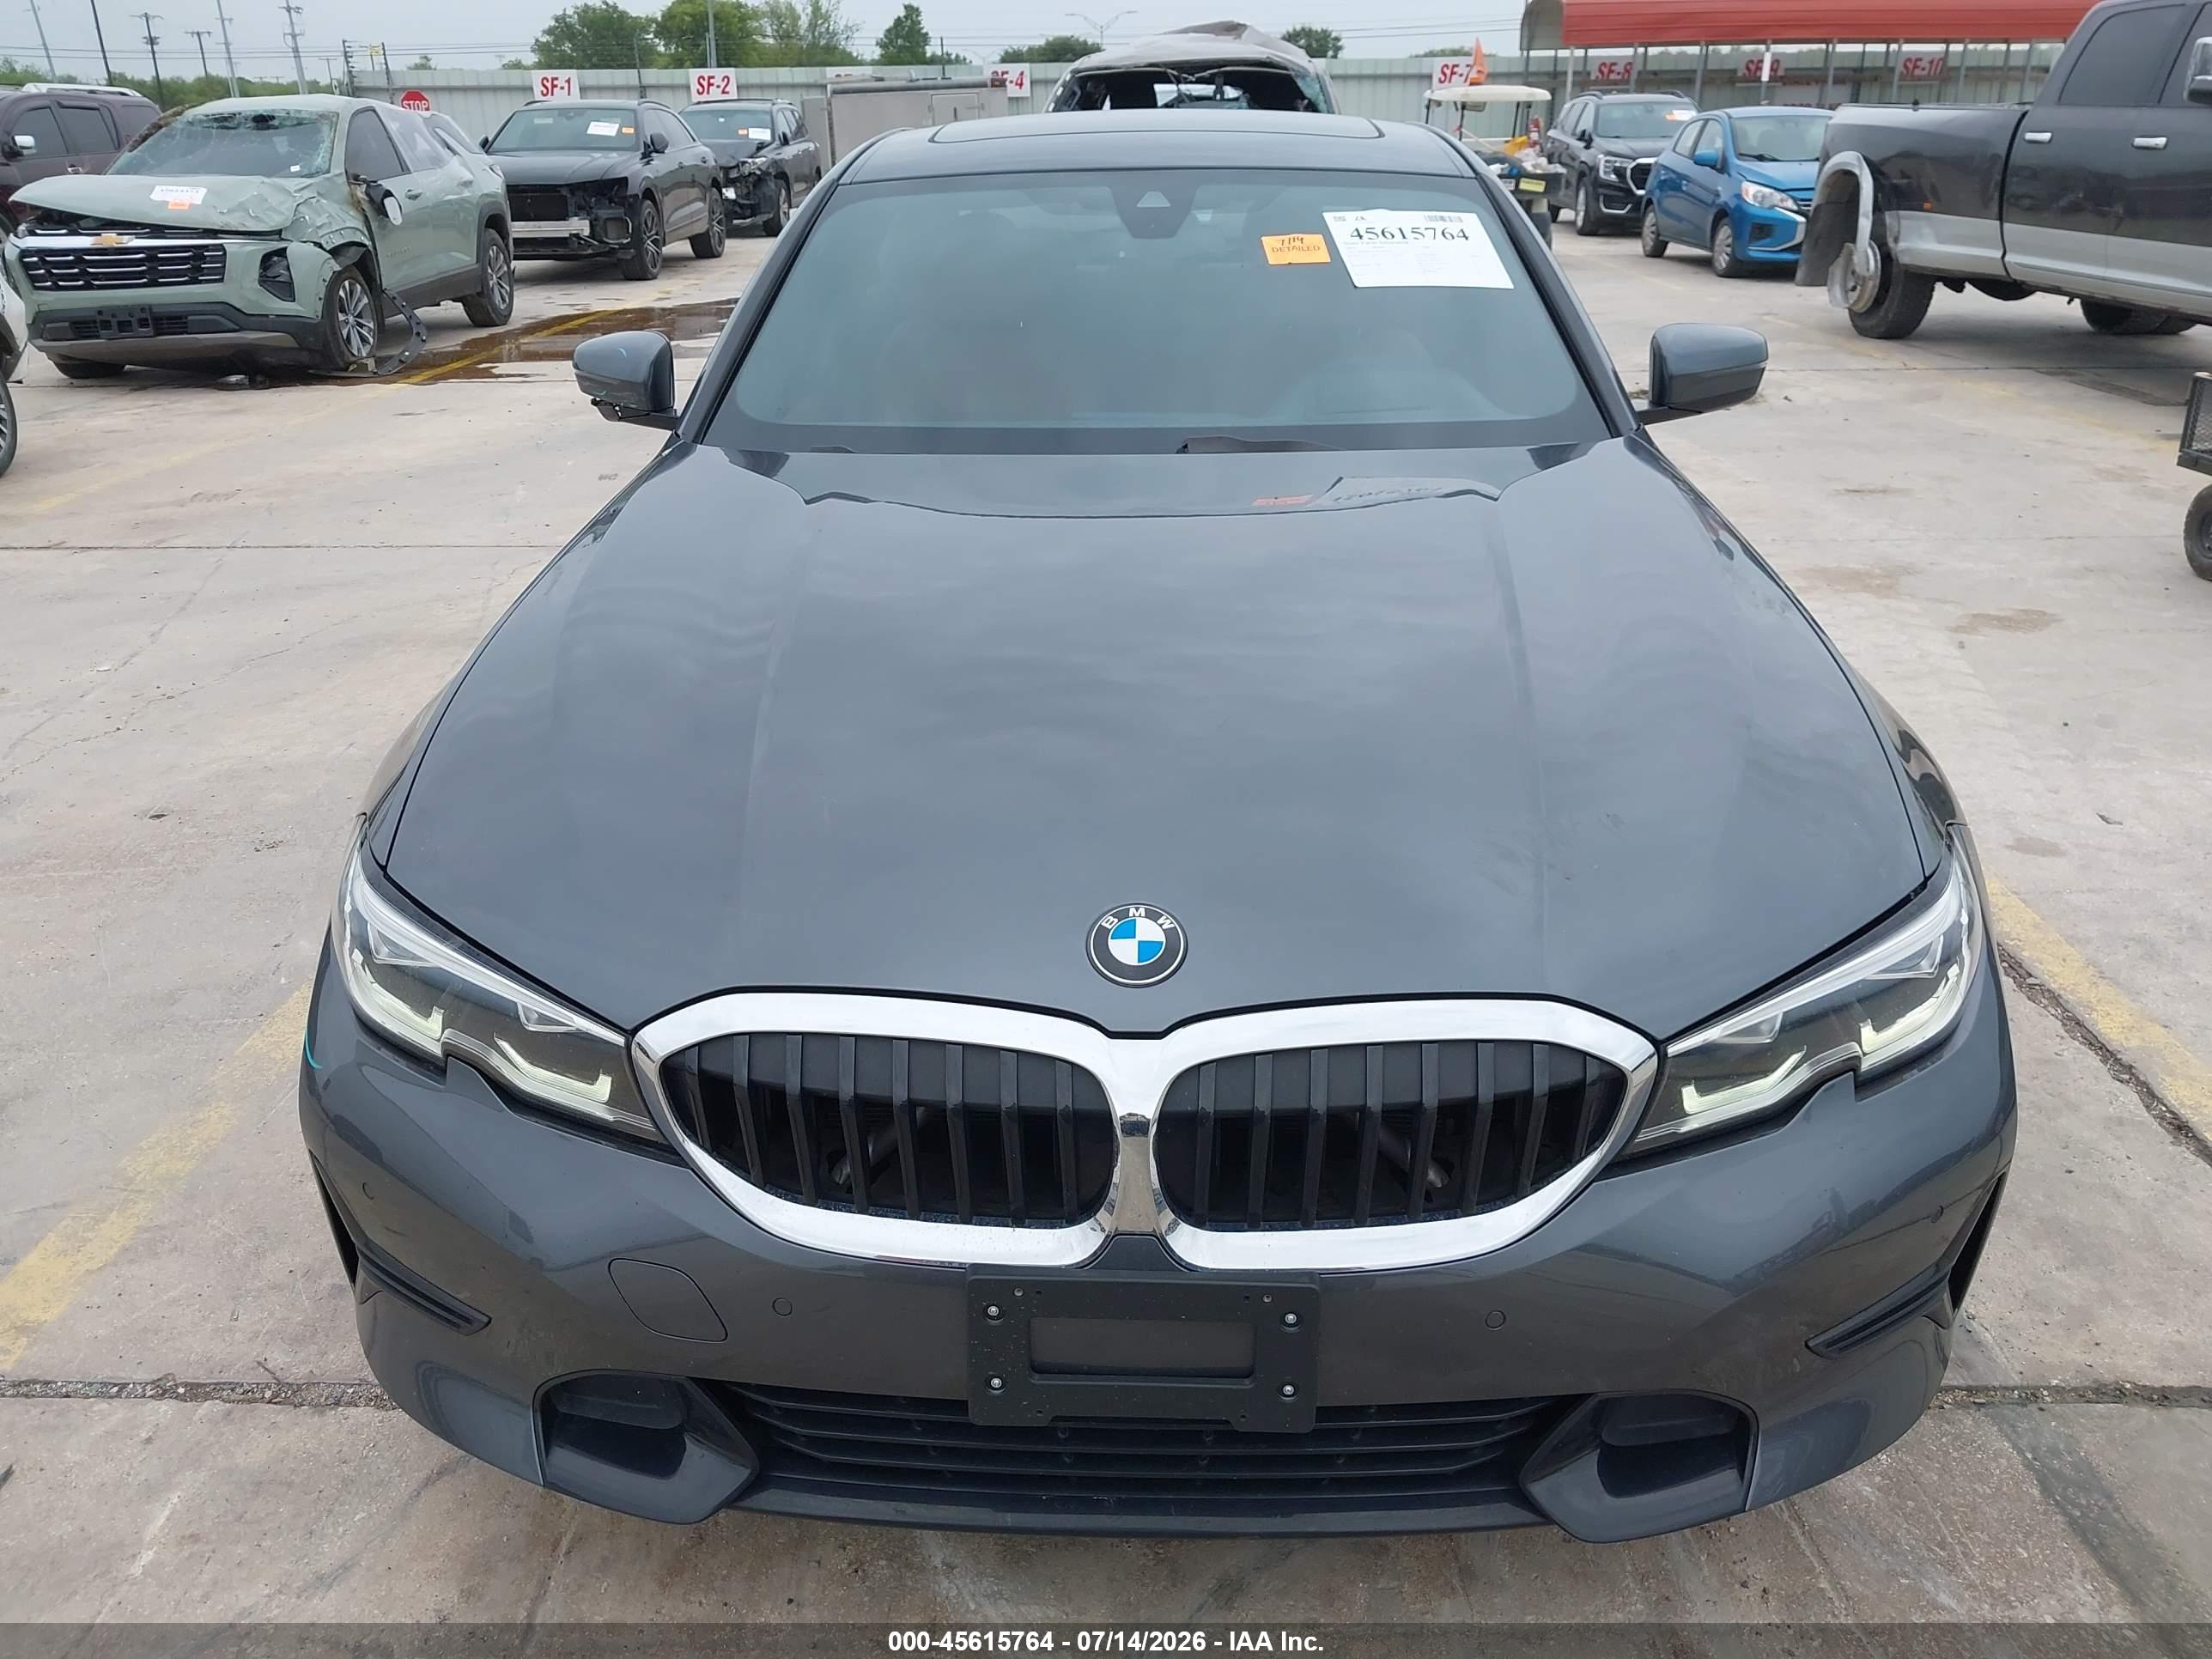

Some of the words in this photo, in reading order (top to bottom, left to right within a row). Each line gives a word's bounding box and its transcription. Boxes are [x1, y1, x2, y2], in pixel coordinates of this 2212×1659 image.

[1900, 57, 1944, 76] SF-10
[540, 76, 571, 96] SF-1
[696, 75, 730, 96] SF-2
[402, 100, 428, 111] STOP
[1350, 227, 1469, 240] 45615764
[1101, 907, 1176, 930] BMW
